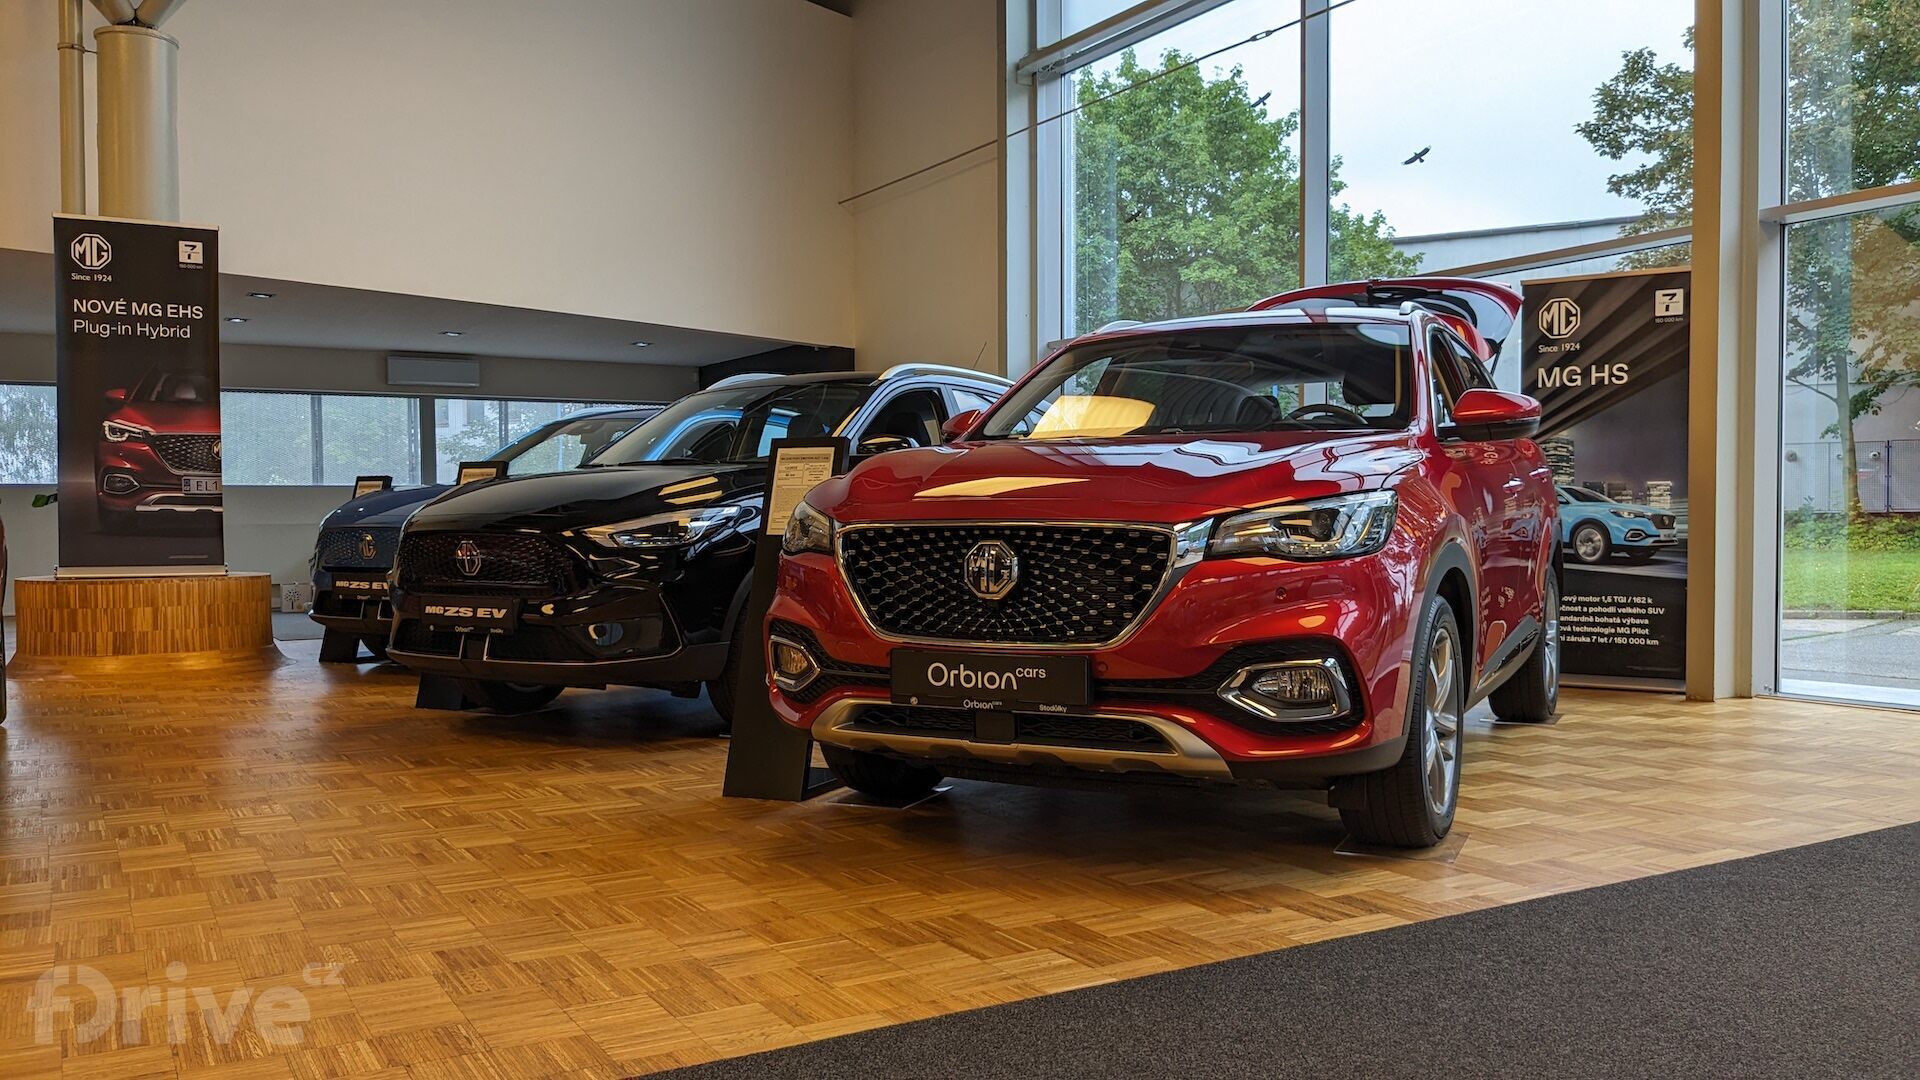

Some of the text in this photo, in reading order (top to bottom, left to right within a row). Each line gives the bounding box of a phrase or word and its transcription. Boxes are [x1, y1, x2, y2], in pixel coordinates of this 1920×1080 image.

[73, 235, 110, 268] MG
[71, 272, 112, 282] Since 1924
[74, 298, 204, 320] NOVÉ MG EHS
[1541, 299, 1578, 337] MG
[74, 320, 190, 340] Plug-in Hybrid
[1538, 342, 1580, 353] Since 1924
[1538, 364, 1628, 388] MG HS
[966, 542, 1014, 597] MG
[476, 608, 507, 618] EV
[1595, 616, 1620, 624] bohatá
[1622, 617, 1649, 625] výbava
[1572, 626, 1615, 634] technologie
[927, 662, 1046, 690] Orbion cars
[962, 699, 994, 710] Orbion
